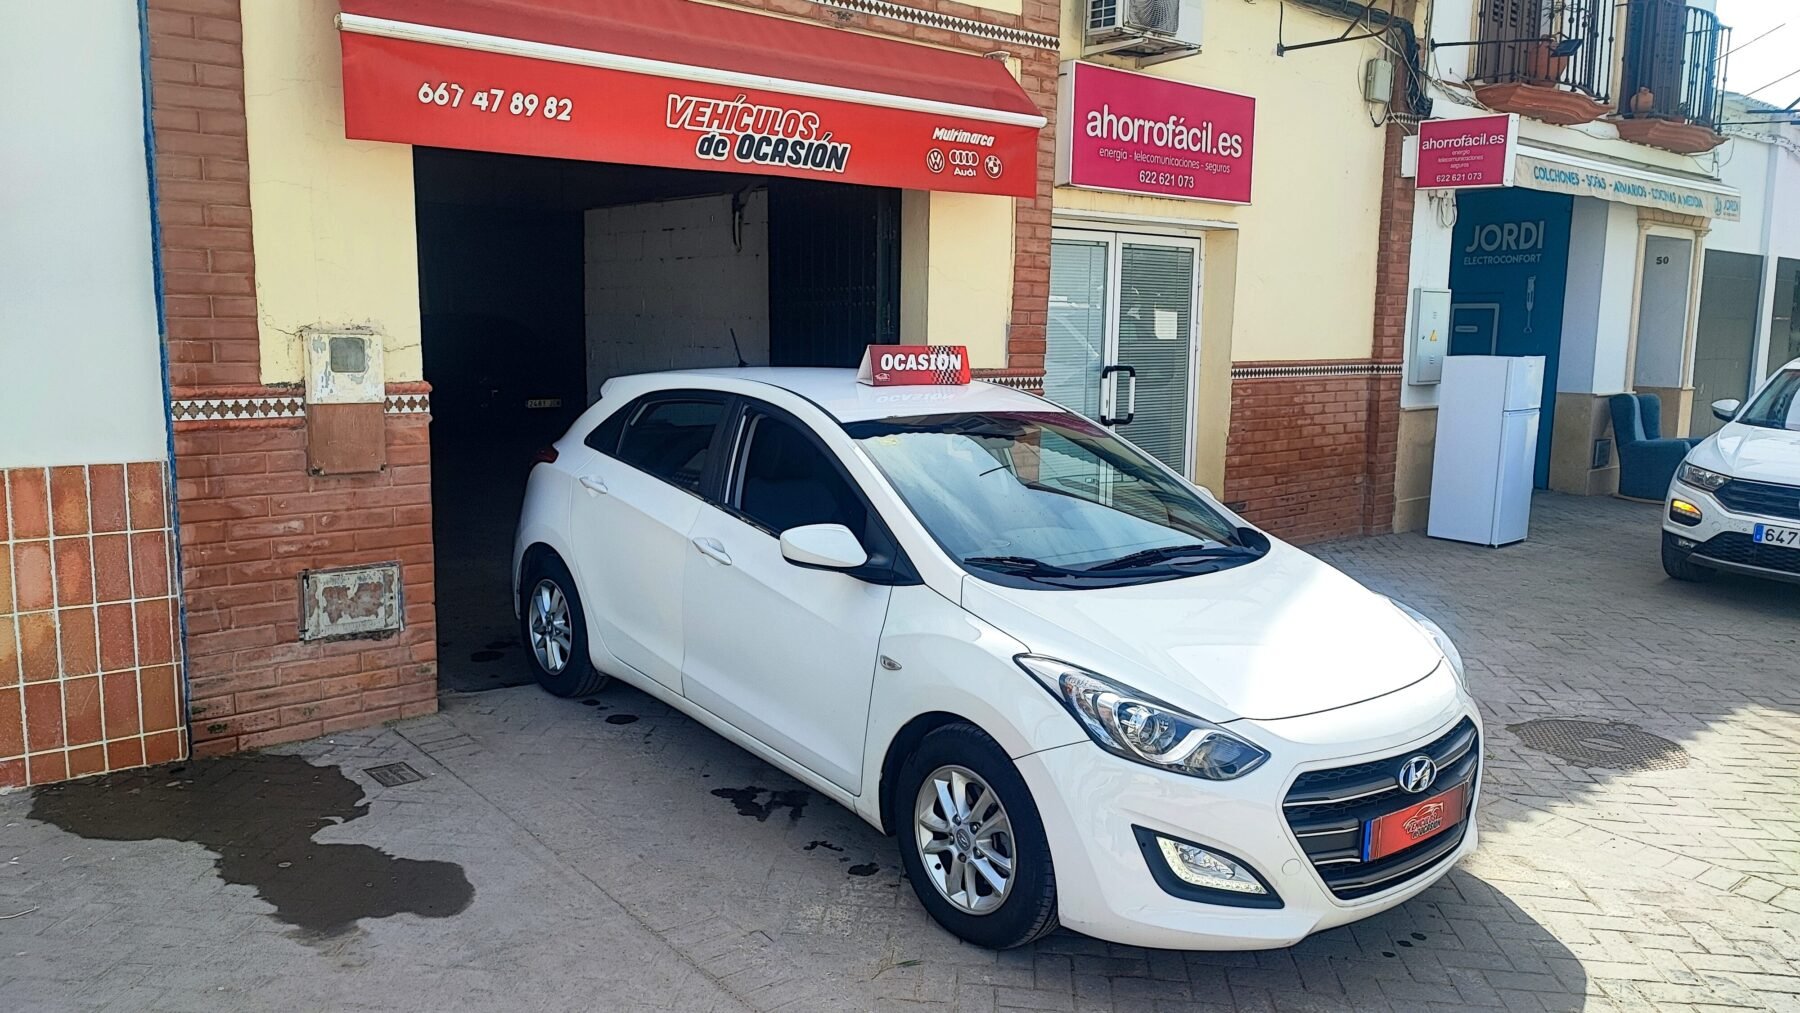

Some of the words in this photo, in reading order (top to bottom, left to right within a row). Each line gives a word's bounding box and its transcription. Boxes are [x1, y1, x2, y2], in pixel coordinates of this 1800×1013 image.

[418, 82, 464, 107] 667
[472, 89, 504, 112] 47
[510, 92, 539, 117] 89
[543, 96, 573, 121] 82
[667, 94, 820, 140] VEHÍCULOS
[1086, 104, 1243, 158] ahorrofácil.es
[1422, 133, 1505, 150] ahorrofácil.es
[696, 133, 730, 159] de
[735, 132, 850, 173] OCASIÓN
[1099, 148, 1127, 161] energía
[1134, 151, 1200, 169] telecomunicaciones
[1205, 162, 1231, 174] seguros
[954, 167, 977, 176] Audi
[1139, 170, 1157, 184] 622
[1159, 172, 1175, 186] 621
[1177, 175, 1195, 188] 073
[1436, 174, 1449, 183] 622
[1452, 173, 1465, 181] 621
[1467, 172, 1482, 180] 073
[1533, 166, 1580, 186] COLCHONES
[1465, 220, 1545, 253] JORDI
[1464, 253, 1542, 265] ELECTROCONFORT
[1656, 256, 1669, 265] 50
[1765, 528, 1800, 546] 647
